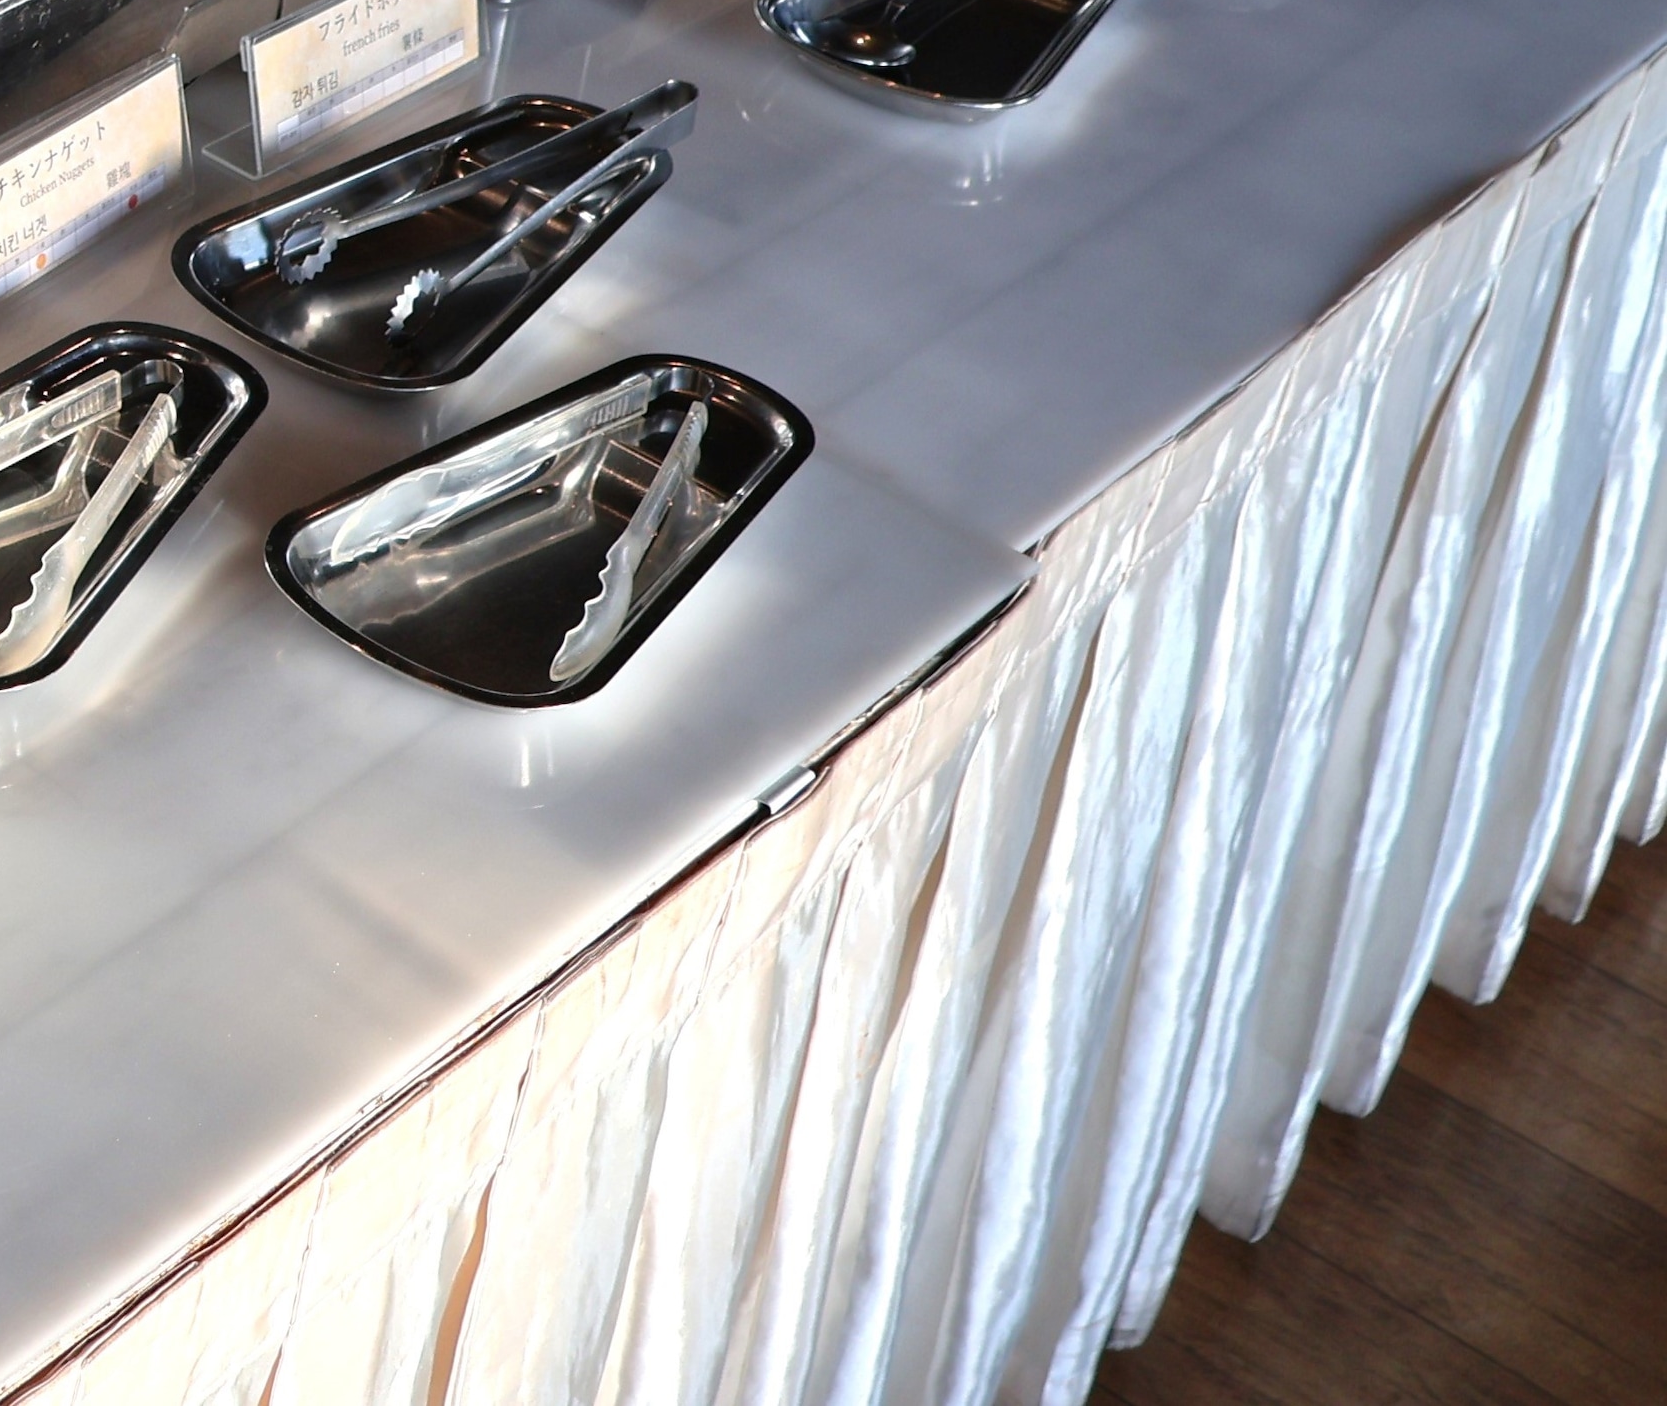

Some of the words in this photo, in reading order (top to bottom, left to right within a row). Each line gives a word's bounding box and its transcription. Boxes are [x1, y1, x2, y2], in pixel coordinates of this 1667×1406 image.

[342, 31, 376, 57] french
[378, 19, 401, 47] fries
[19, 179, 58, 208] Chicken
[59, 155, 96, 186] Nuggets
